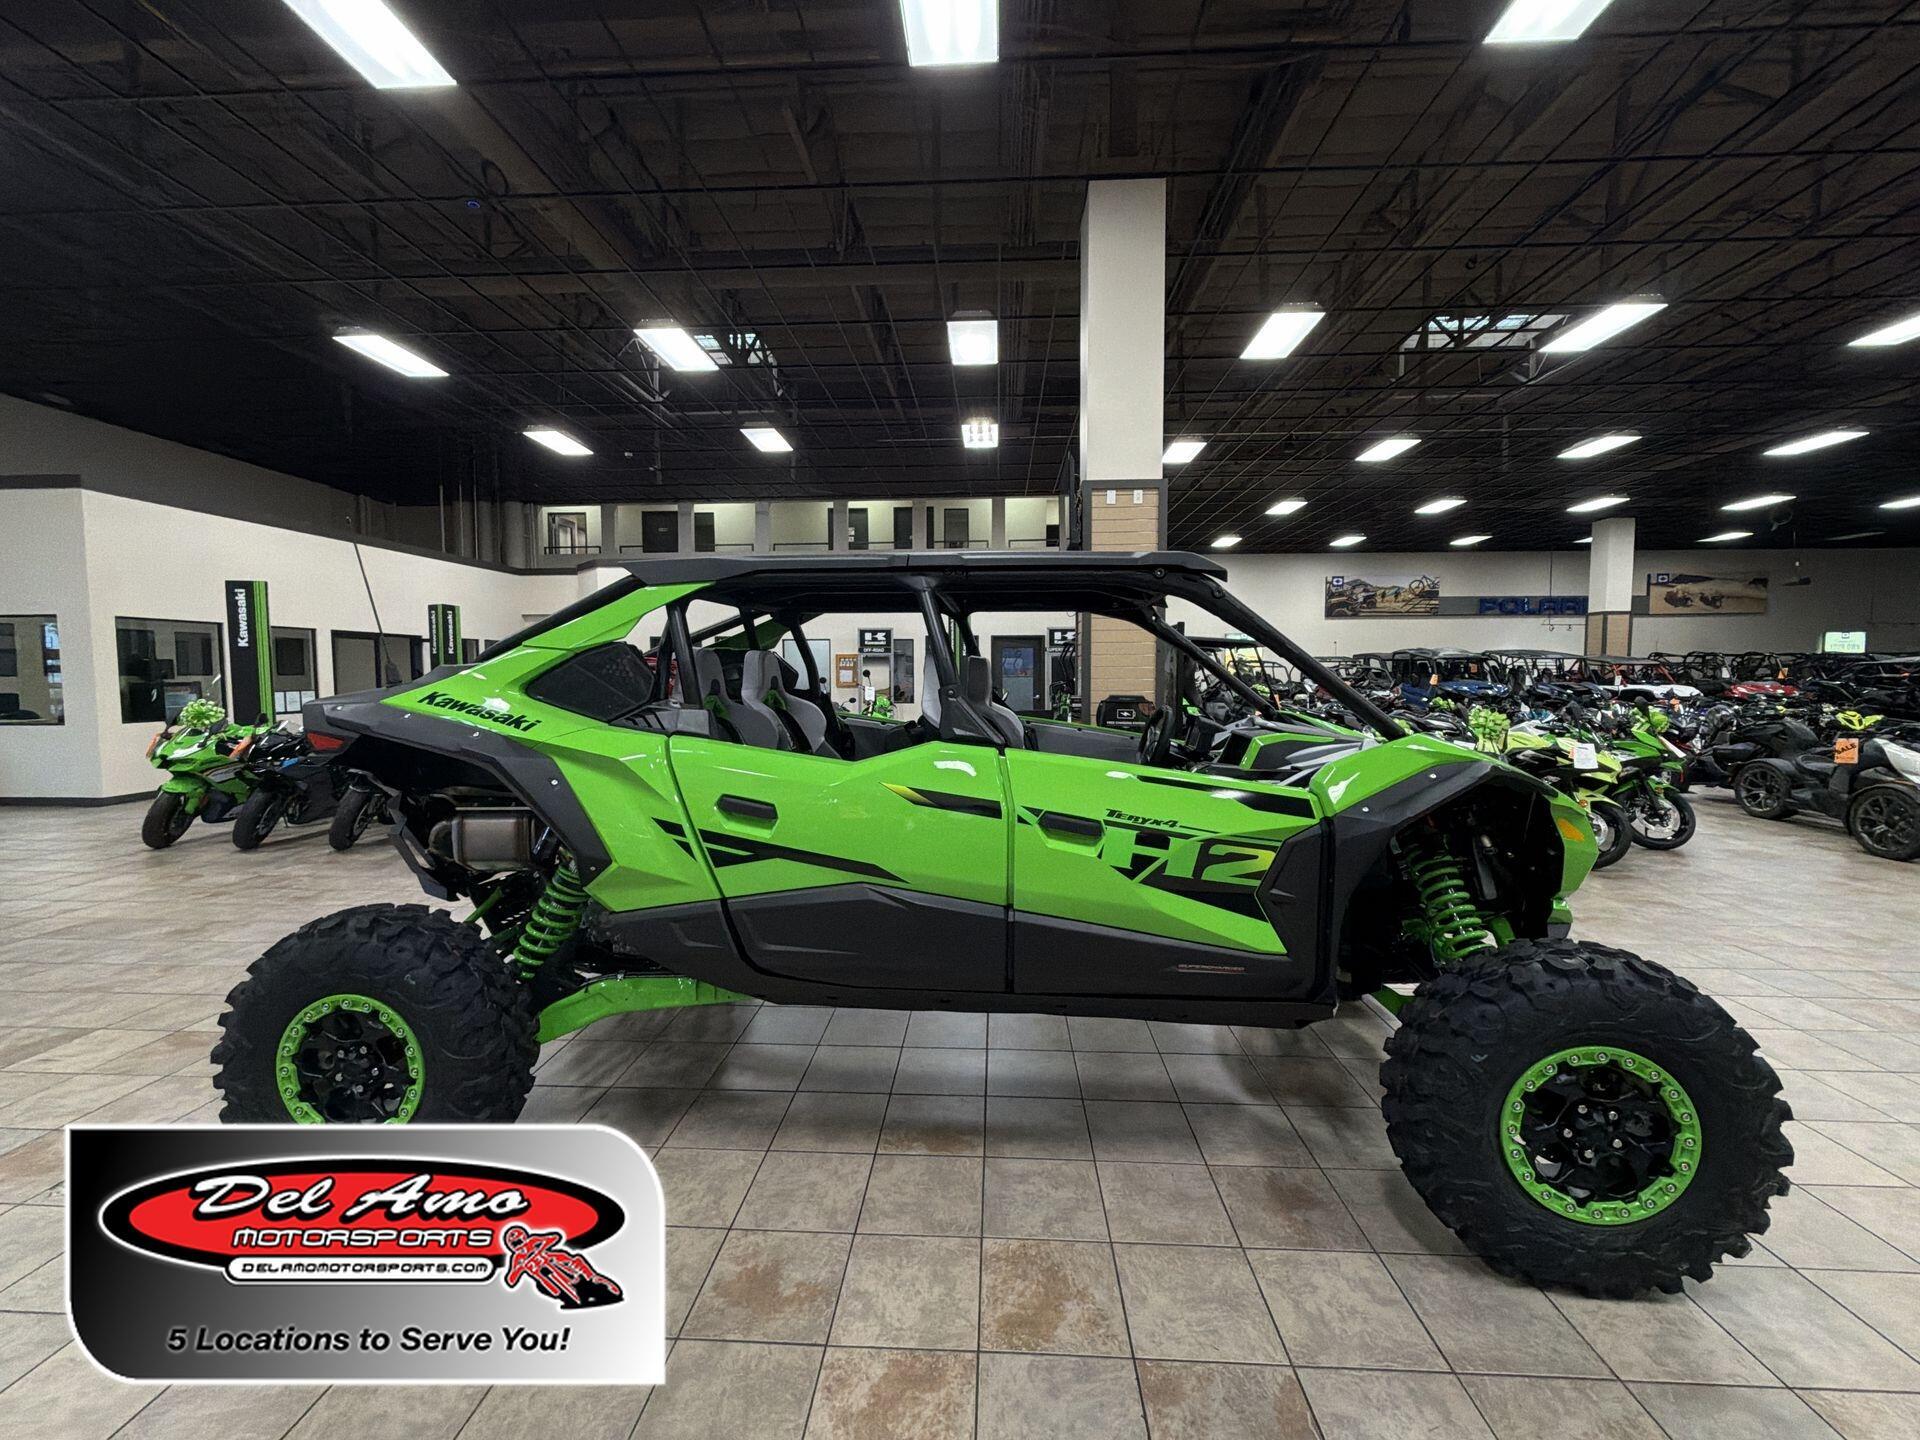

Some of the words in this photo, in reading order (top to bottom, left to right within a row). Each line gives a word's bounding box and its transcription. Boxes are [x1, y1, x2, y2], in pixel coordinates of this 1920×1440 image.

[234, 588, 249, 647] Kawasaki
[1479, 597, 1589, 615] POLARI
[417, 691, 542, 732] Kawasaki
[1102, 826, 1277, 887] H2
